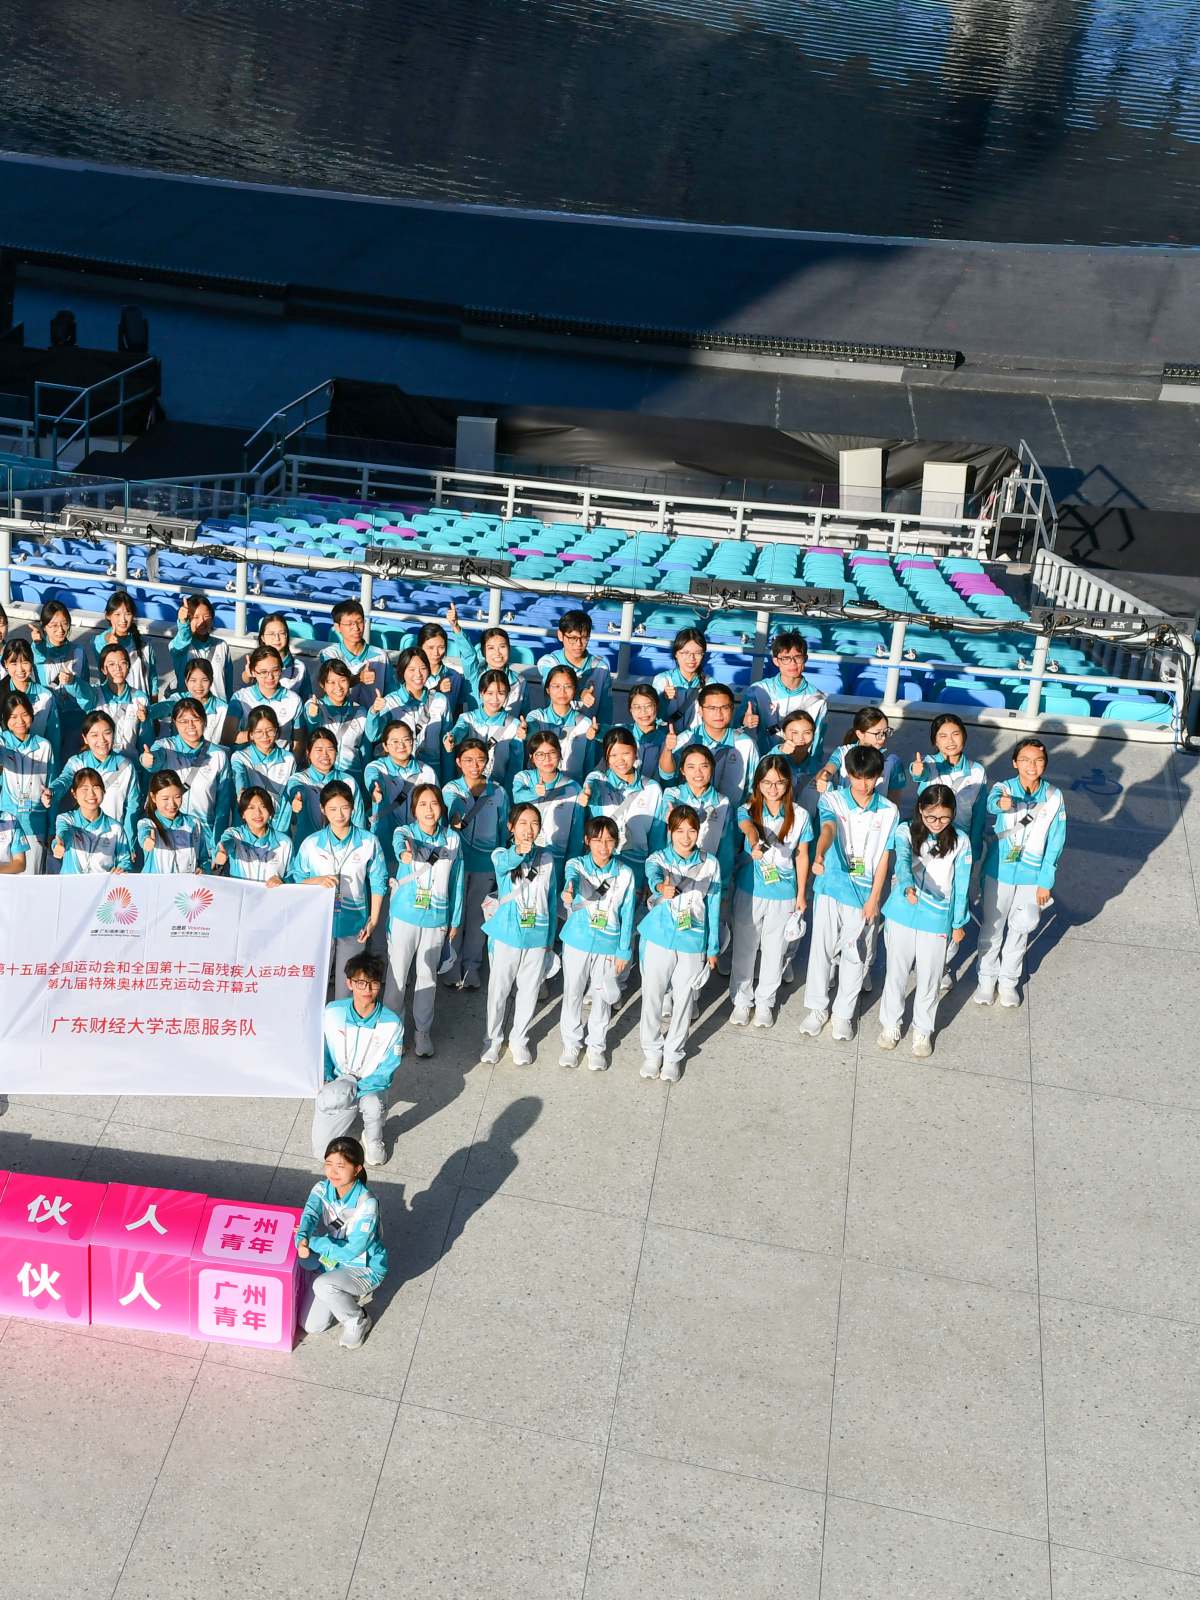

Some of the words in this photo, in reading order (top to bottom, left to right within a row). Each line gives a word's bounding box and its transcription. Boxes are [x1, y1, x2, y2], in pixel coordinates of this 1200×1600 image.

[47, 976, 259, 994] 第九届特殊奥林匹克运动会开幕式
[51, 1016, 257, 1037] 广东财经大学志愿服务队
[224, 1214, 278, 1235] 广州
[220, 1233, 274, 1254] 青年
[214, 1281, 266, 1306] 广州
[213, 1306, 267, 1331] 青年
